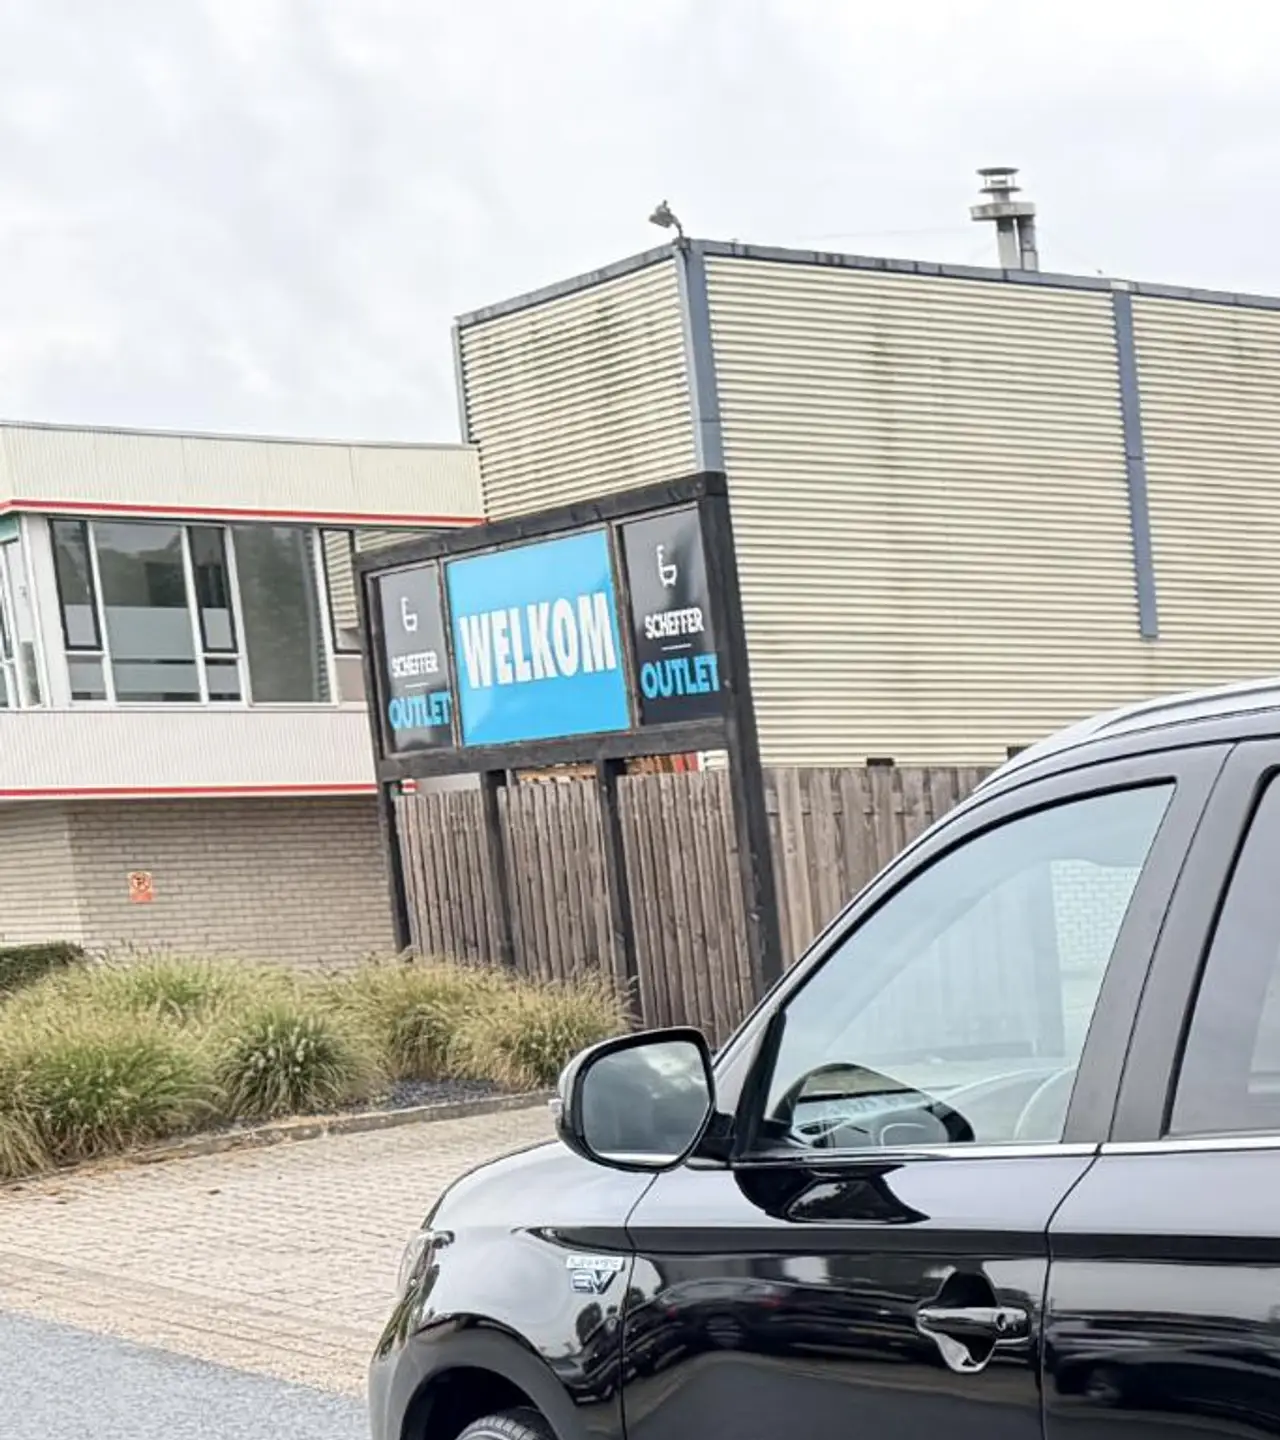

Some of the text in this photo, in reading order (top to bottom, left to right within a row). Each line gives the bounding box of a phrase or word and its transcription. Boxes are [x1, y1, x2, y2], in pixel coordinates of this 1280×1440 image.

[458, 592, 617, 689] WELKOM
[644, 607, 705, 639] SCHEFFER
[391, 651, 439, 678] SCHEFFER
[641, 653, 720, 699] OUTLET
[388, 691, 452, 729] OUTLET
